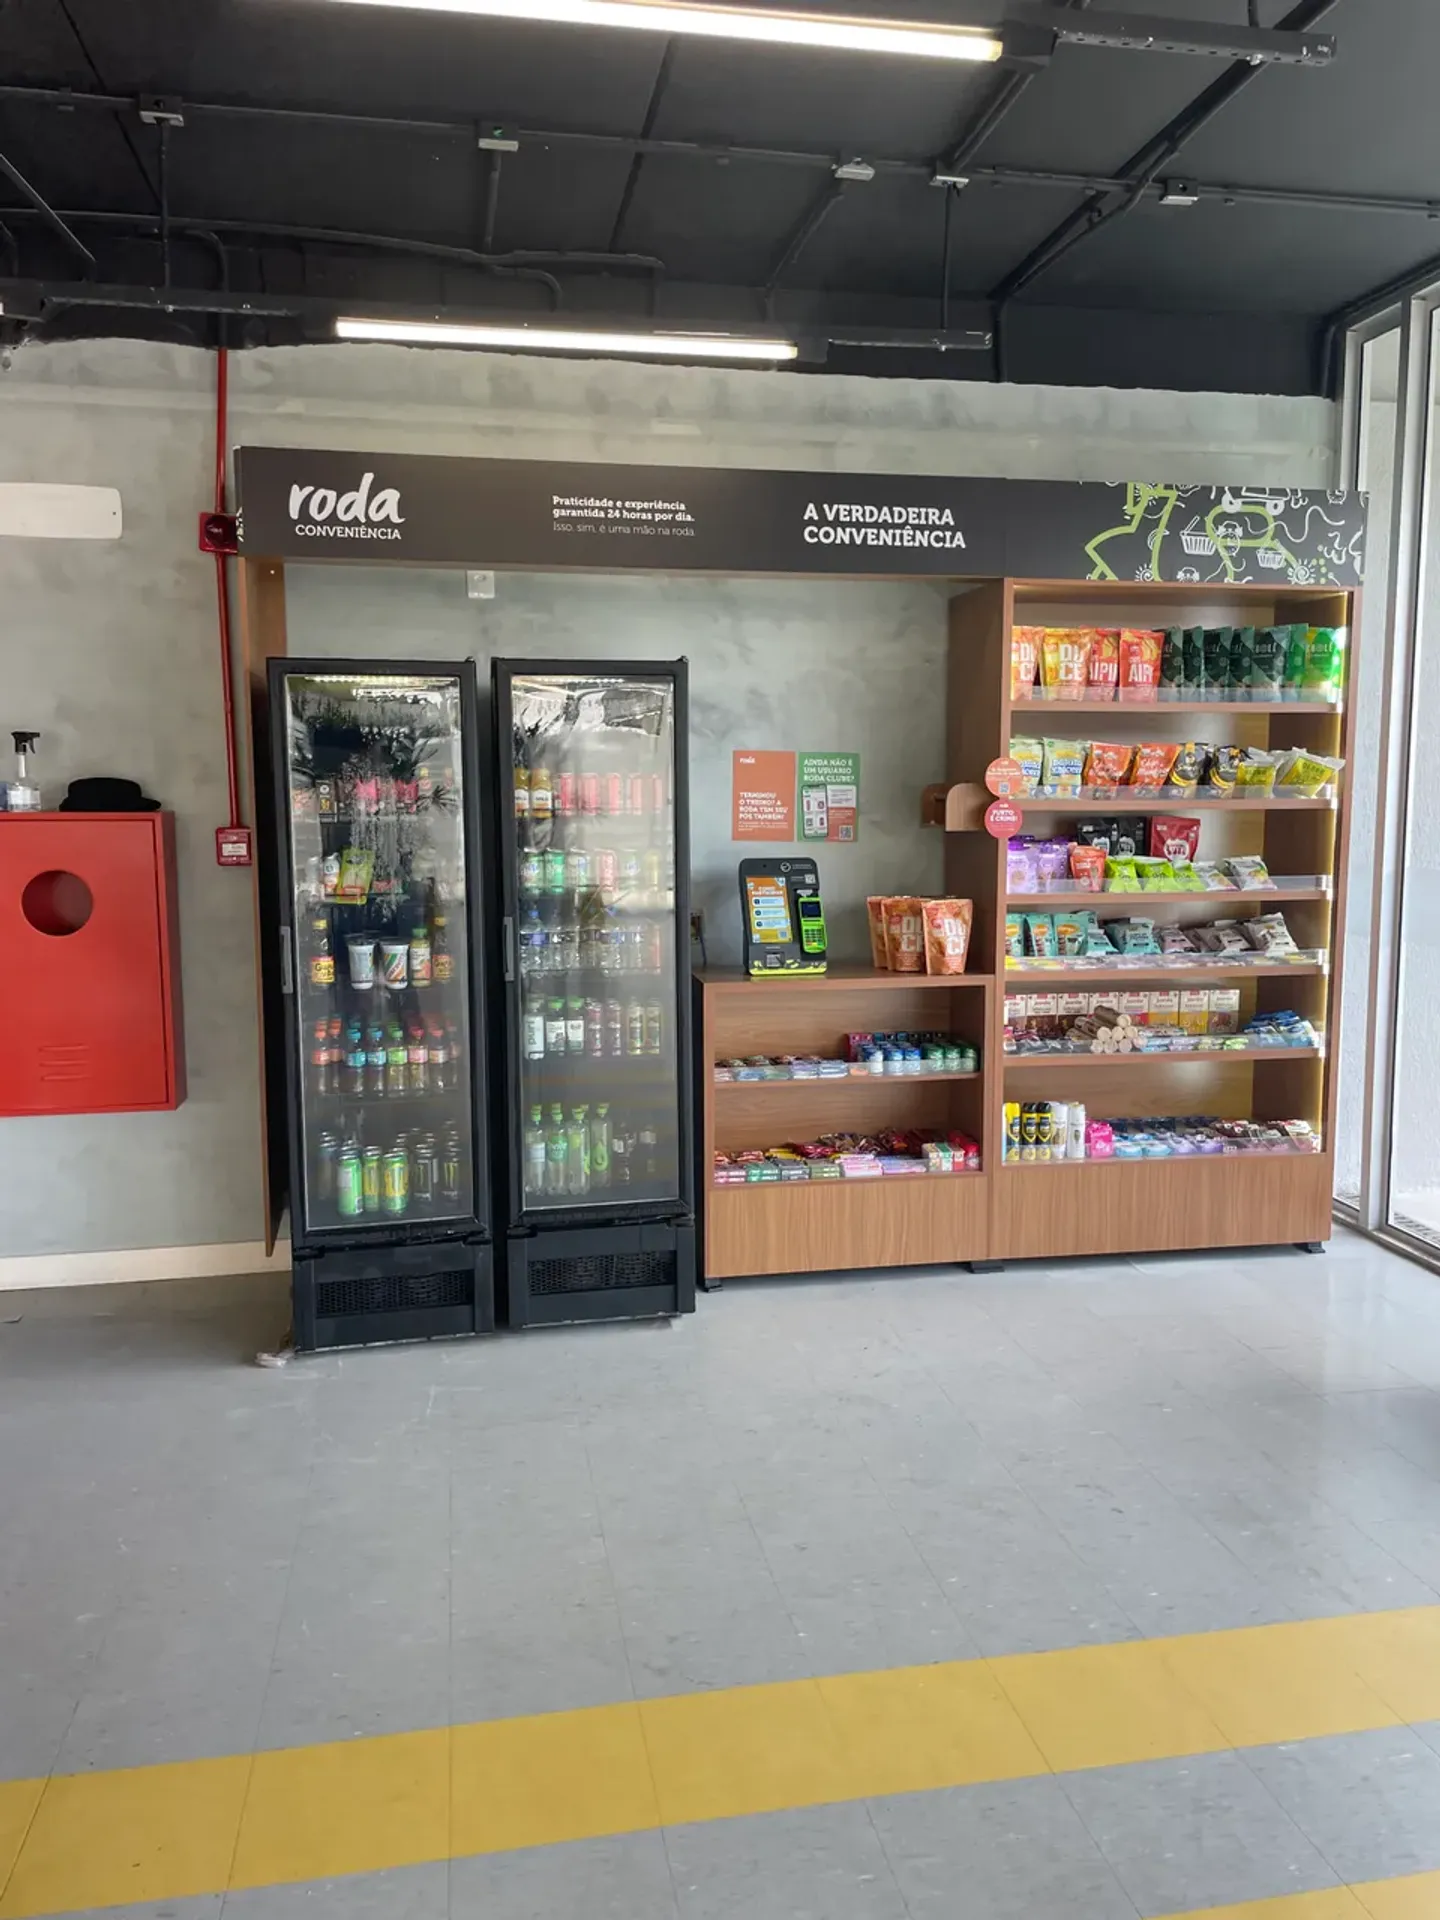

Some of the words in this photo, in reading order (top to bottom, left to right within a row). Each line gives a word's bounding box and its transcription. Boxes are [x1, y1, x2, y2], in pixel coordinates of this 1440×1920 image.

[289, 472, 406, 524] roda
[552, 495, 614, 508] Praticidade
[615, 500, 622, 508] e
[624, 500, 686, 511] experiência
[552, 508, 605, 519] garantida
[607, 508, 621, 518] 24
[622, 509, 652, 520] horas
[654, 511, 673, 522] por
[675, 512, 695, 522] dia.
[803, 502, 819, 521] A
[822, 503, 955, 526] VERDADEIRA
[295, 524, 402, 540] CONVENIÊNCIA
[803, 525, 967, 548] CONVENIÊNCIA
